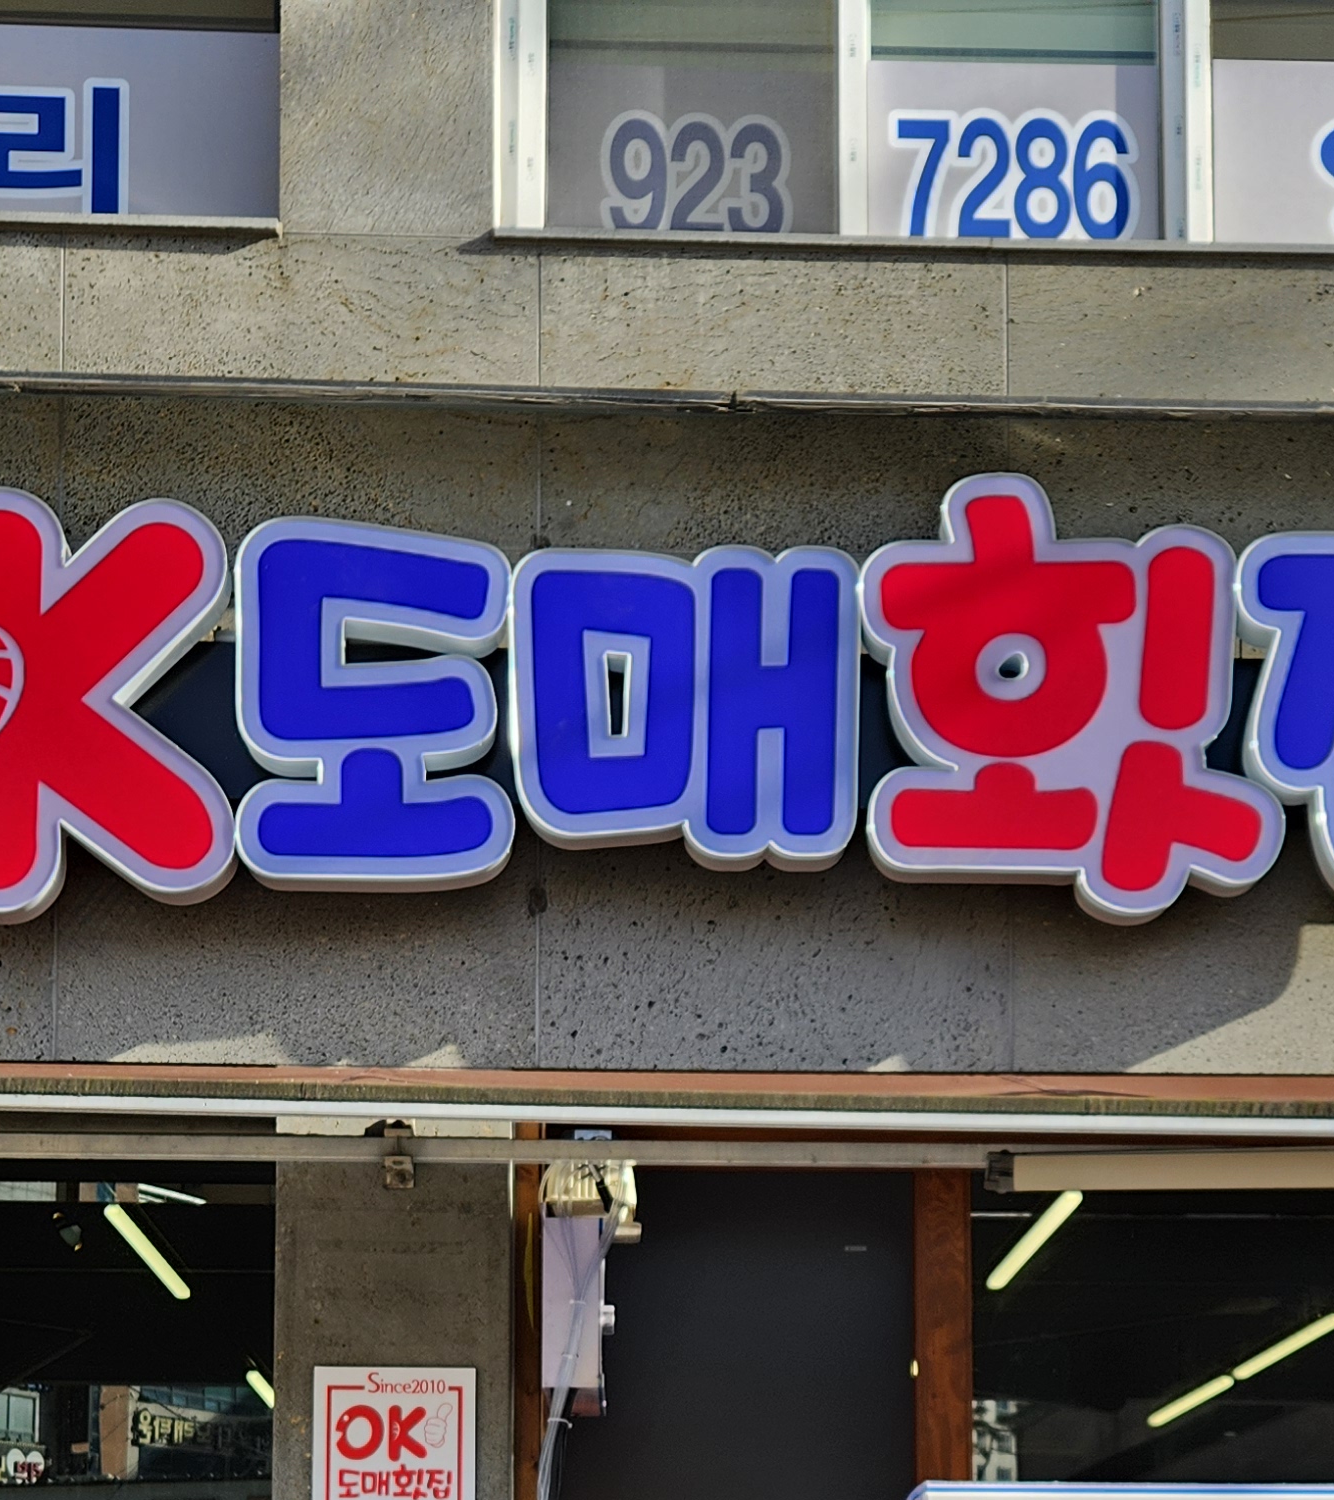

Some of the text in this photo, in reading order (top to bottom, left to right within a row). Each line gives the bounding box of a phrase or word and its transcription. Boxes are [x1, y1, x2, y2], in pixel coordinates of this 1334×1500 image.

[608, 116, 1131, 240] 923 7286
[335, 1404, 428, 1462] OK
[338, 1463, 453, 1500] 도매횟집
